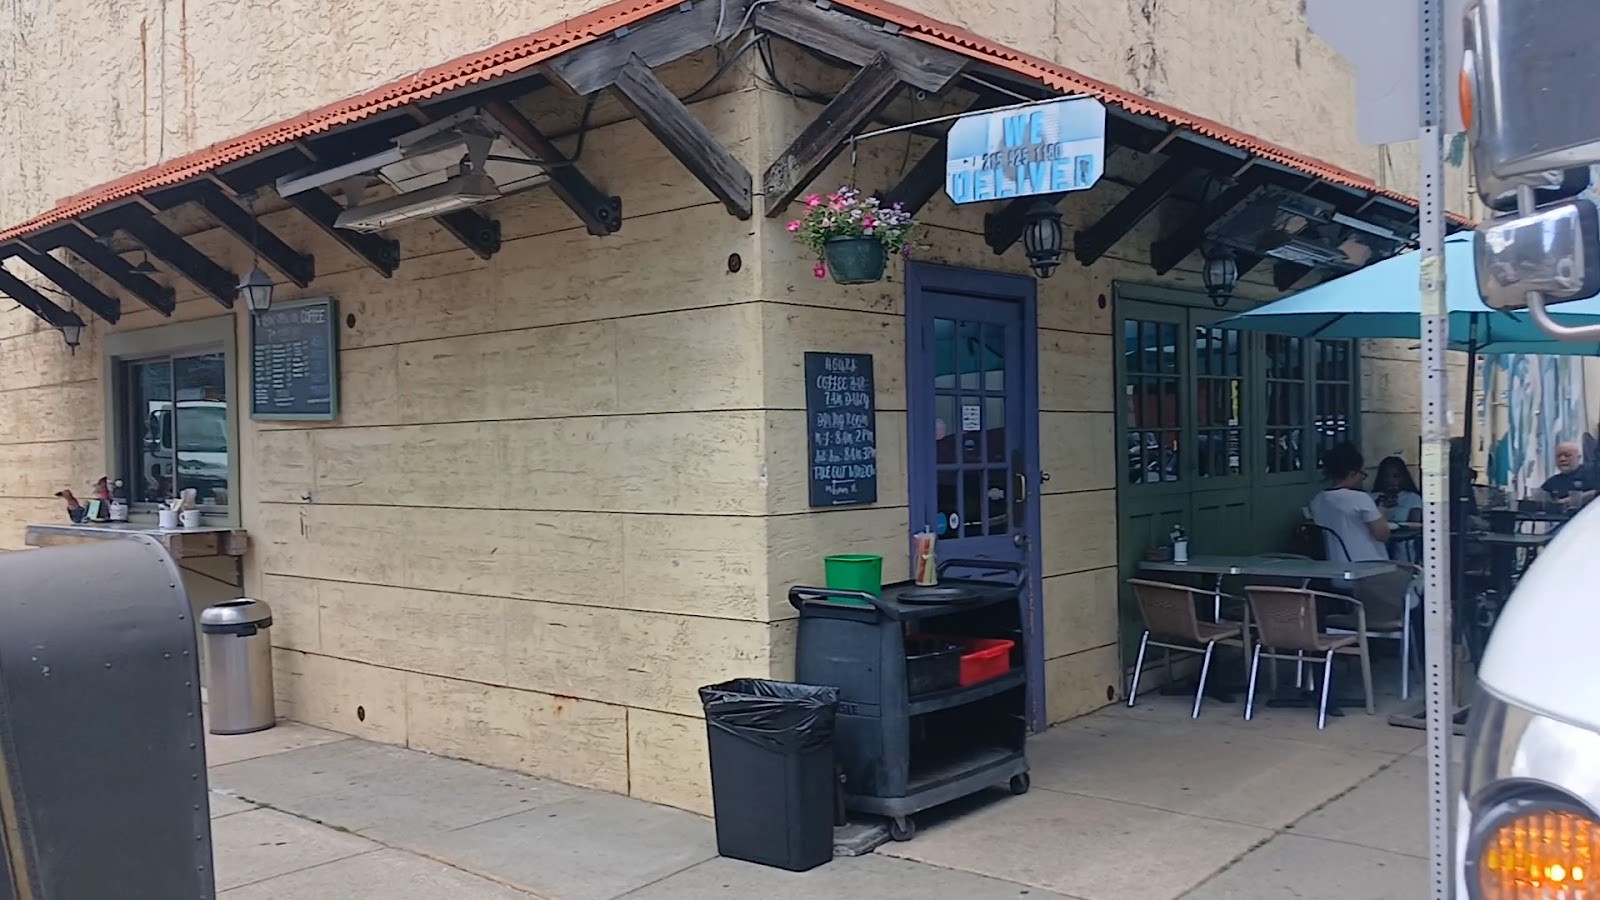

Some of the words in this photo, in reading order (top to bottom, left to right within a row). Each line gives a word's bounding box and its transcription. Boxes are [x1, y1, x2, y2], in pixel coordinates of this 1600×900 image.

[1003, 111, 1044, 147] WE
[953, 154, 1094, 201] DELIVER
[825, 357, 857, 373] HOURS
[816, 375, 848, 391] COFFEE
